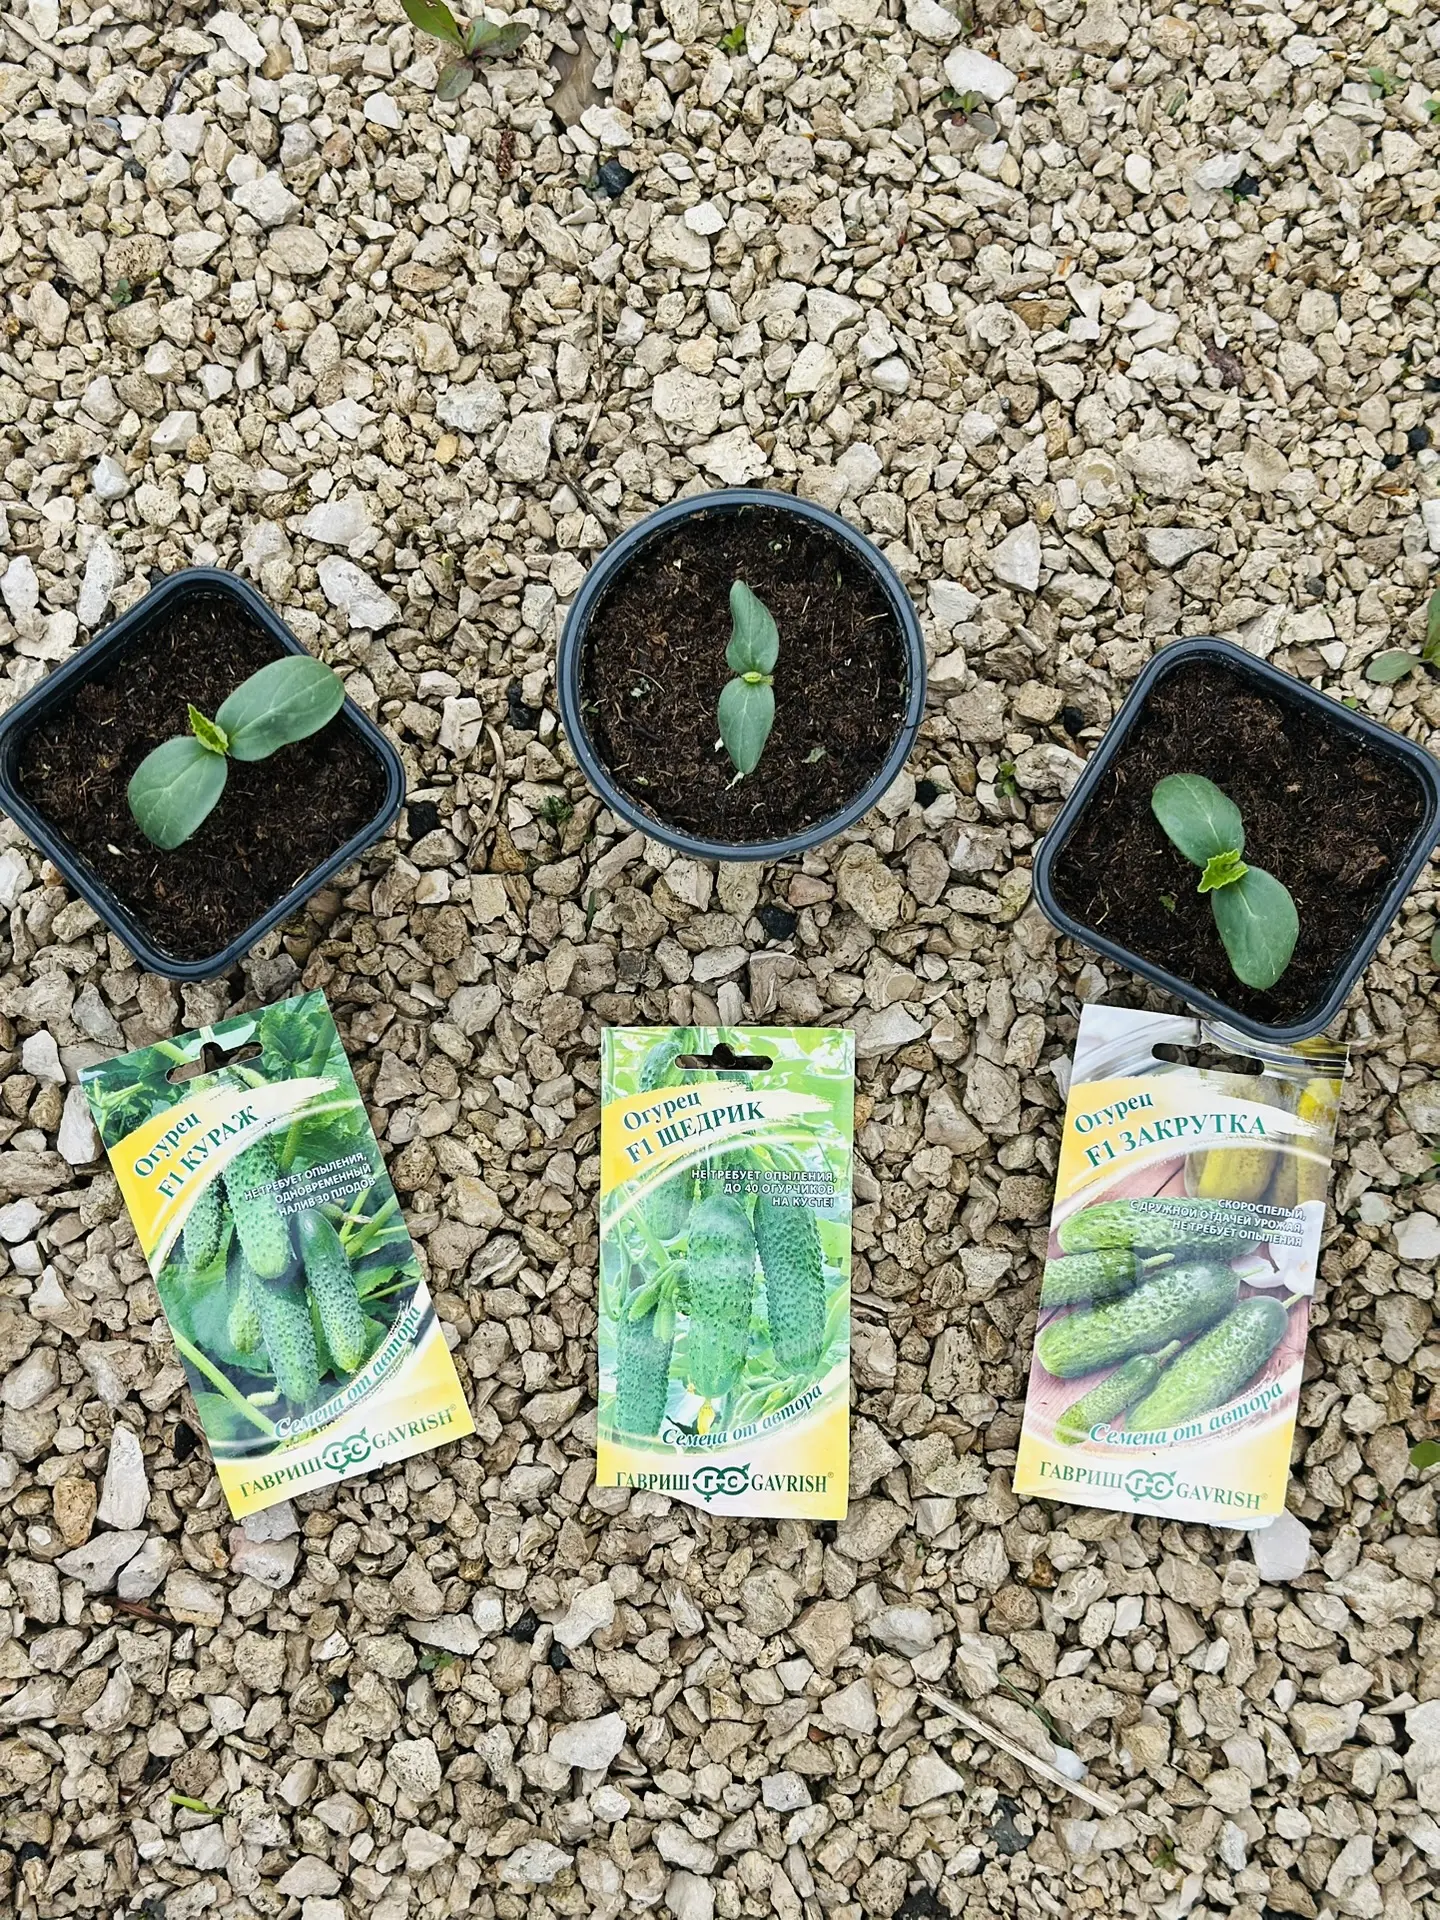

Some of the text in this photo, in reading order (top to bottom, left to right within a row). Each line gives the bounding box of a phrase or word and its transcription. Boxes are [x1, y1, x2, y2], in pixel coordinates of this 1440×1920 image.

[623, 1091, 702, 1131] Огурец
[1074, 1093, 1154, 1134] Огурец
[135, 1113, 202, 1177] Огурец
[158, 1105, 260, 1198] F1 КУРАЖ
[625, 1101, 766, 1163] F1 ЩЕДРИК
[1085, 1114, 1267, 1167] F1 ЗАКРУТКА
[275, 1163, 372, 1204] ОДНОВРЕМЕННЫЙ
[304, 1152, 367, 1180] ОПЫЛЕНИЯ,
[691, 1169, 837, 1183] НЕ ТРЕБУЕТ ОПЫЛЕНИЯ,
[279, 1177, 376, 1217] НАЛИВ 30 ПЛОДОВ
[723, 1184, 835, 1195] ДО 40 ОГУРЧИКОВ
[772, 1196, 835, 1208] НА КУСТЕ!
[1130, 1200, 1305, 1235] С ДРУЖНОЙ ОТДАЧЕЙ УРОЖАЯ,
[1218, 1199, 1307, 1221] СКОРОСПЕЛЫЙ,
[1172, 1220, 1303, 1248] НЕ ТРЕБУЕТ ОПЫЛЕНИЯ
[275, 1306, 421, 1438] Семена от автора
[662, 1385, 823, 1447] Семена от автора
[1090, 1382, 1283, 1446] Семена от автора
[240, 1457, 323, 1498] ГАВРИШ
[616, 1472, 690, 1491] ГАВРИШ
[1039, 1461, 1124, 1489] ГАВРИШ
